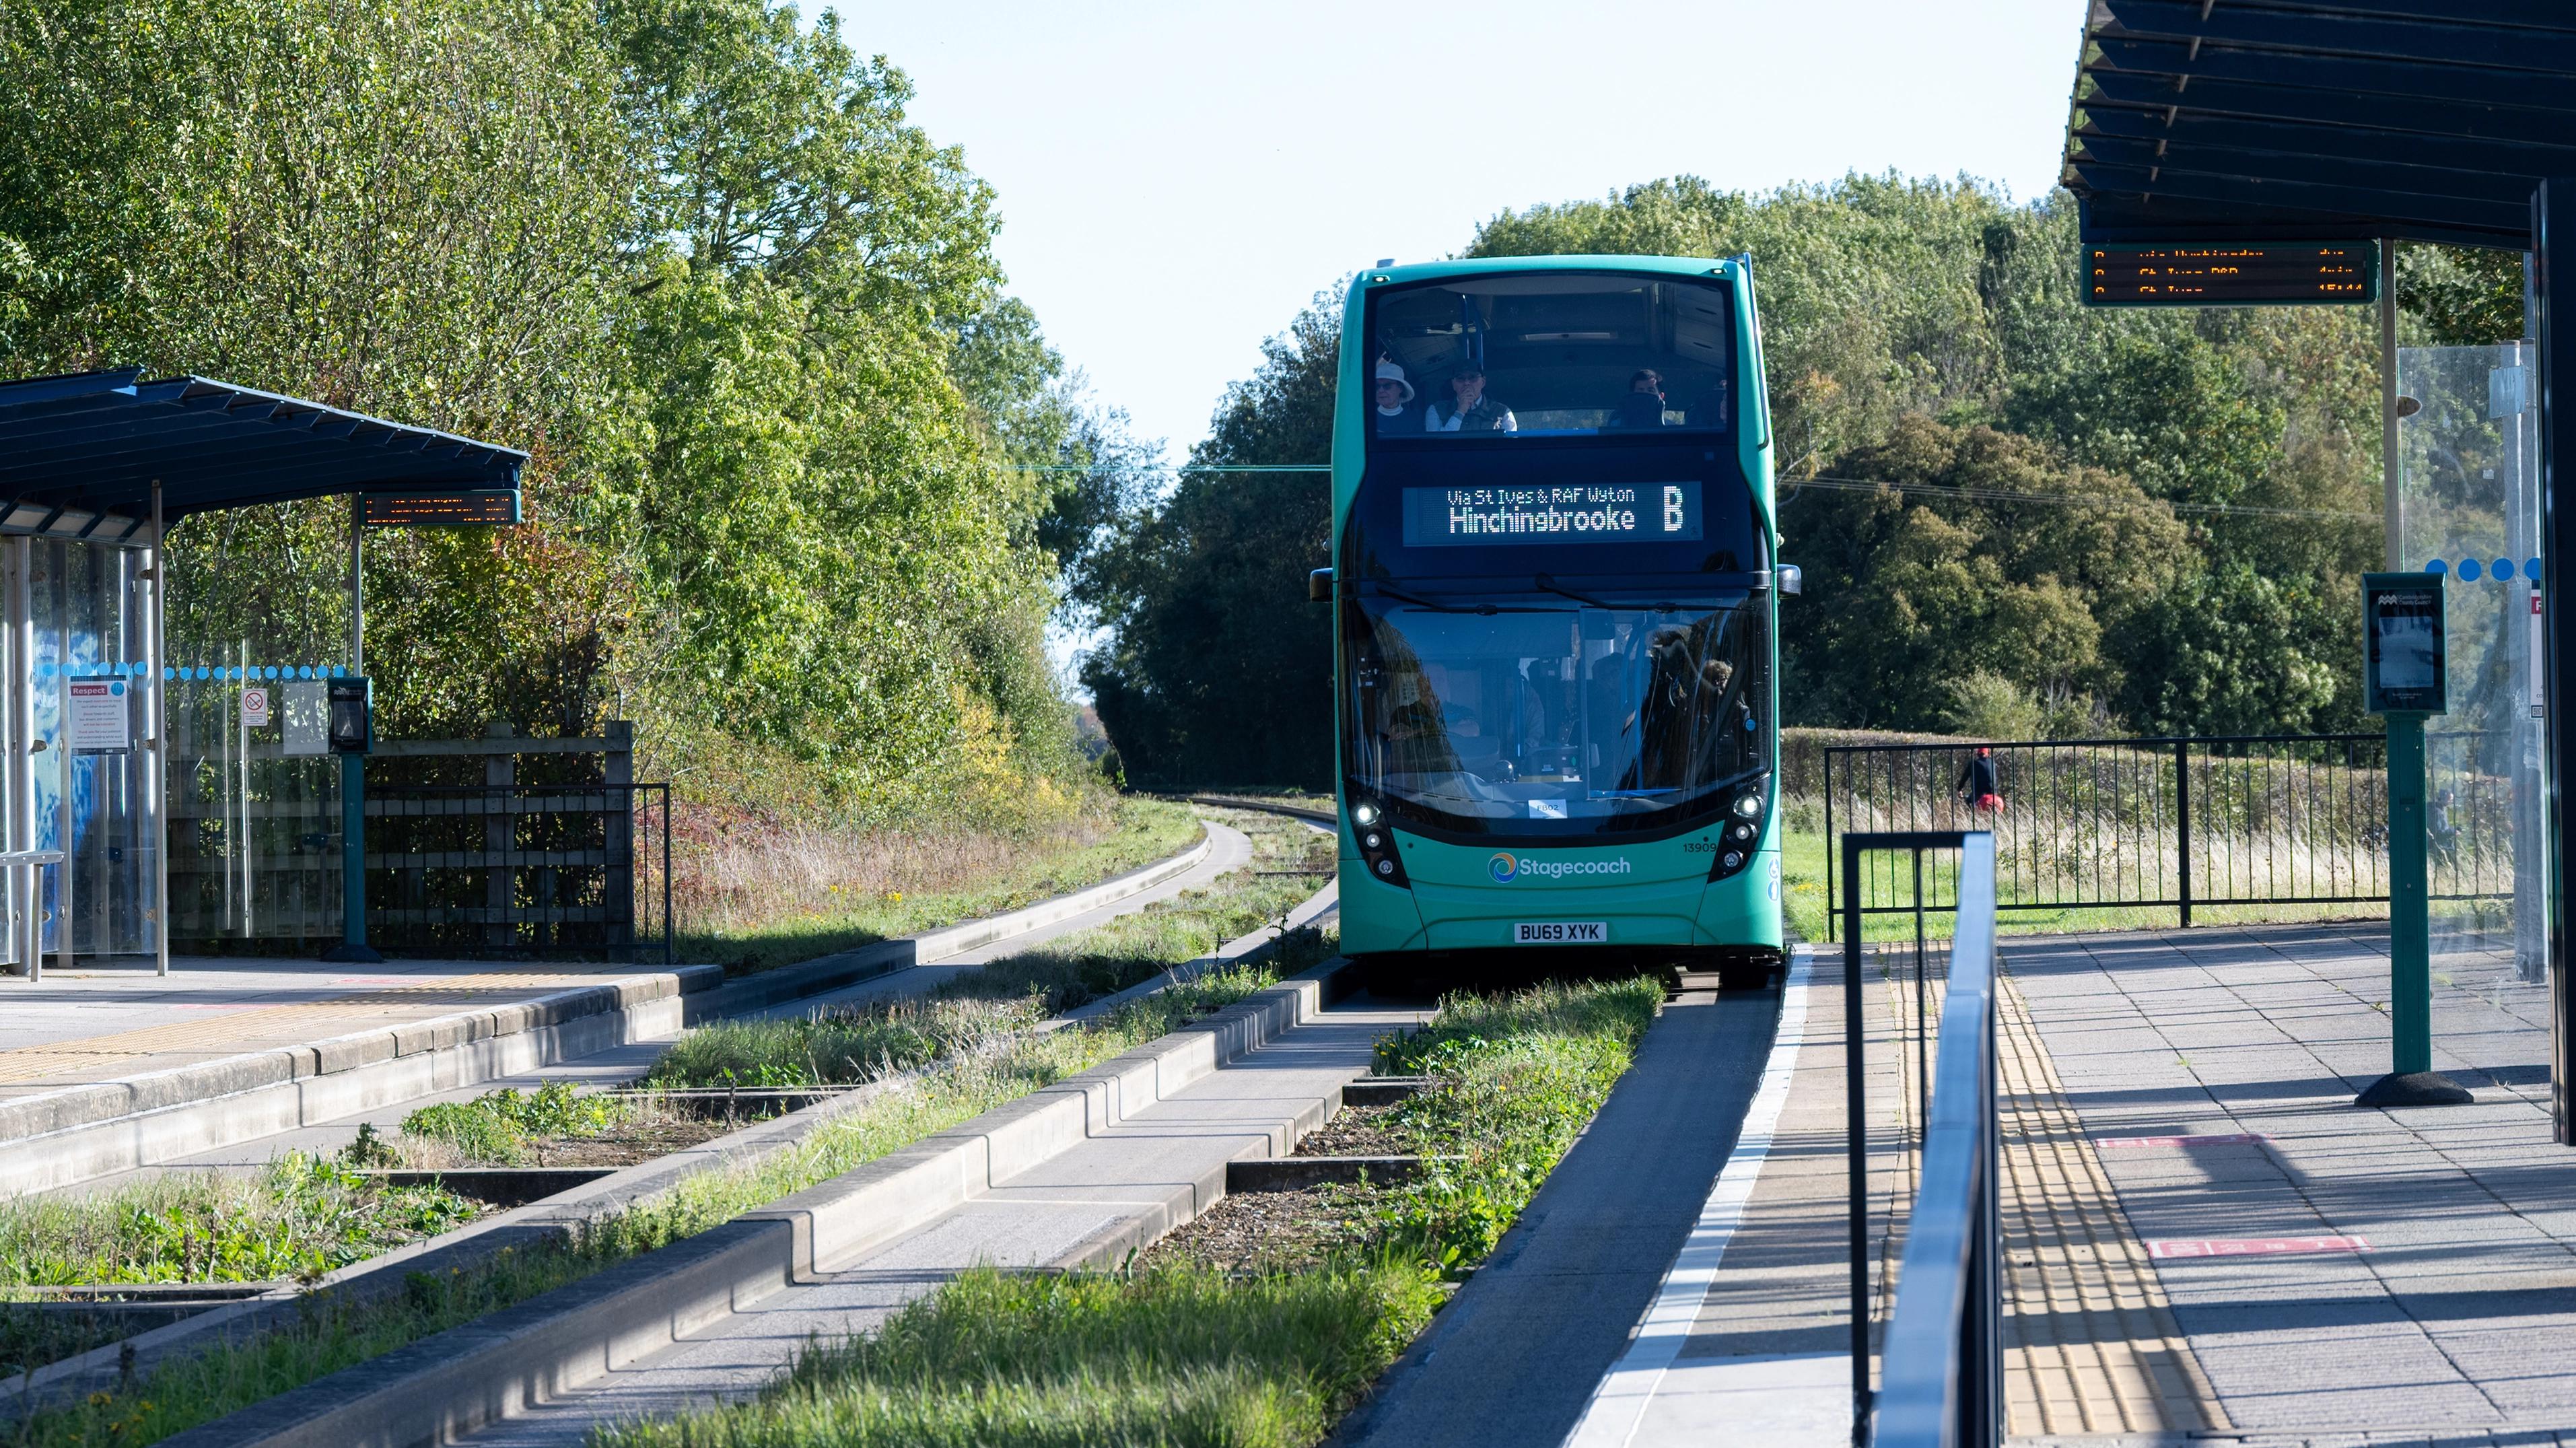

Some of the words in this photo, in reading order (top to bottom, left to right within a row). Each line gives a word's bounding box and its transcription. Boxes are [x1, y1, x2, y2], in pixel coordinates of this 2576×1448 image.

[1447, 490, 1471, 506] Via
[1474, 489, 1494, 505] St
[1498, 489, 1534, 504] Ives
[1537, 489, 1548, 503] &
[1552, 487, 1584, 503] RAF
[1588, 487, 1635, 503] Wyton
[1663, 485, 1683, 532] B
[1683, 843, 1716, 853] 13909
[1519, 857, 1631, 878] Stagecoach
[1520, 925, 1563, 940] BU69
[1568, 924, 1599, 939] XYK
